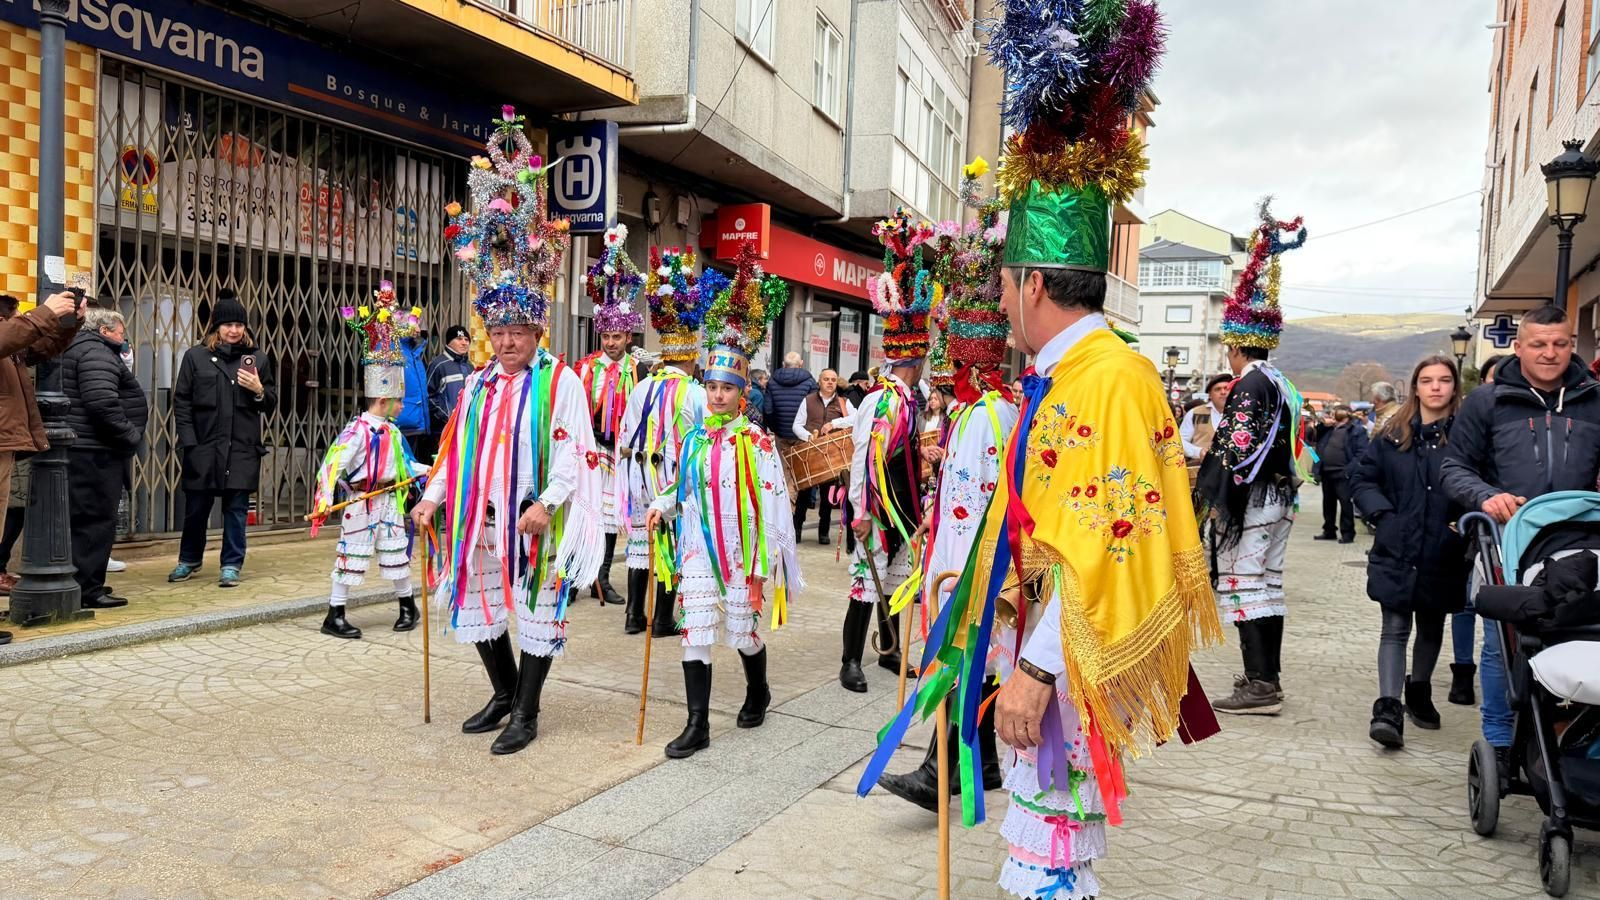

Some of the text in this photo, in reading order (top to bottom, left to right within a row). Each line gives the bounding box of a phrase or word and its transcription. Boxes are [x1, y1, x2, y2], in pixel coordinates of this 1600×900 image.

[326, 74, 488, 140] Bosque & Jardi
[550, 211, 604, 225] Husqvarna
[722, 231, 758, 240] MAPFRE
[709, 355, 742, 371] UXIA
